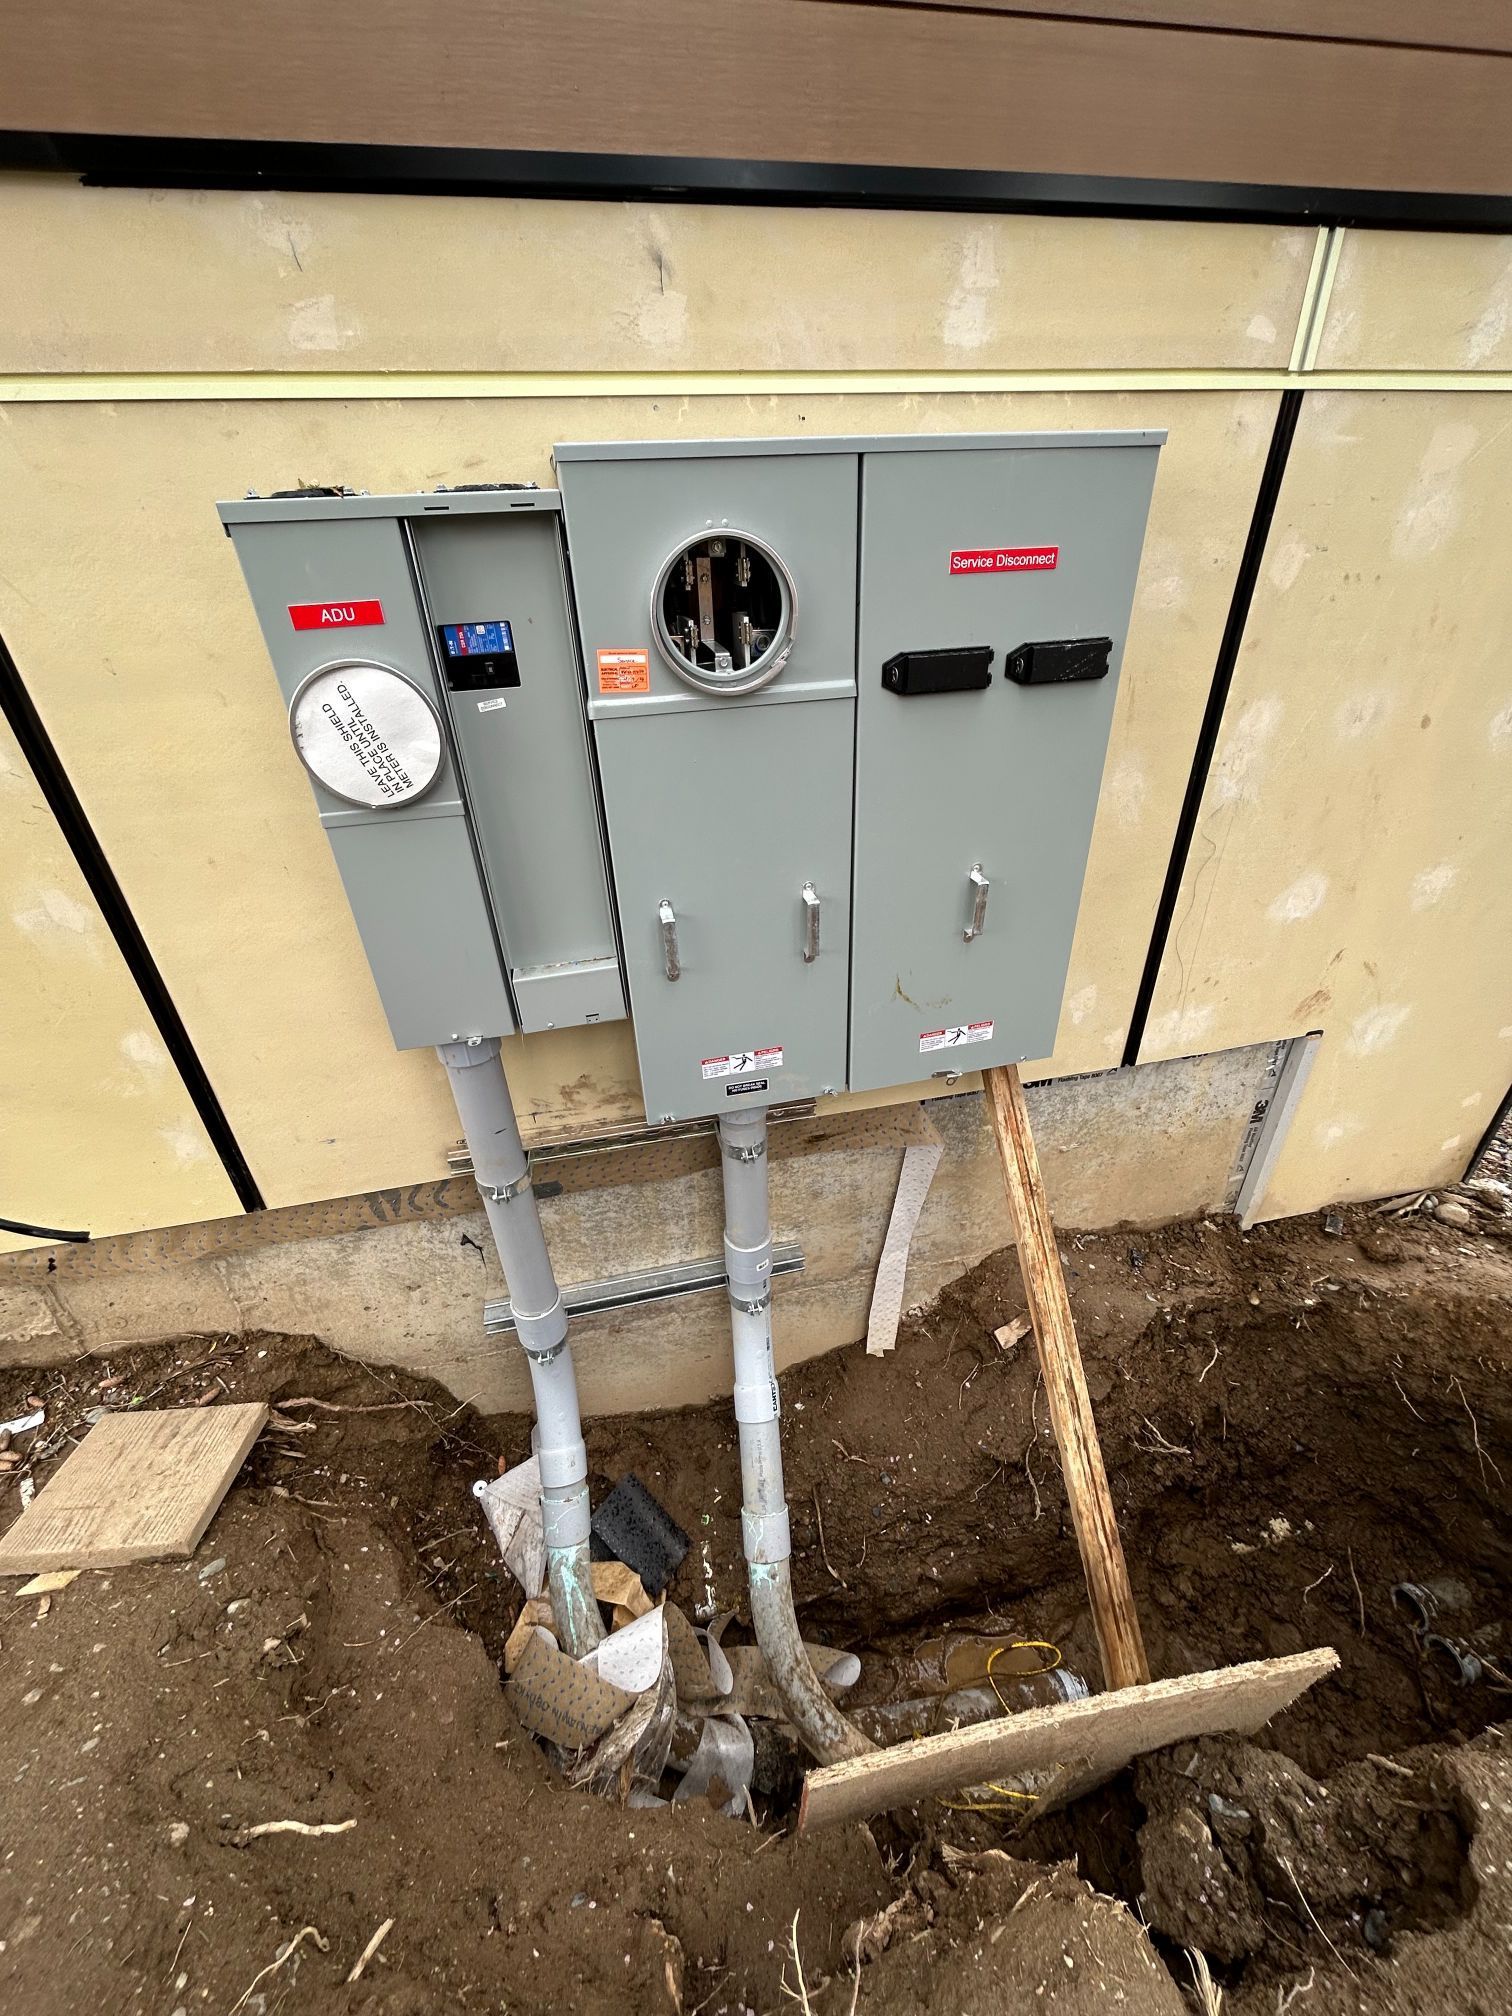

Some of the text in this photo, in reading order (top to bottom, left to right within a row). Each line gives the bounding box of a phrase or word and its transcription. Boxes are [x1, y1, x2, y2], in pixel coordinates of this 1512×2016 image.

[952, 552, 1055, 569] Service Disconnect
[321, 607, 355, 623] ADU
[322, 703, 395, 798] LEAVE THIS SHIELD
[347, 717, 404, 794] IN PLACE UNTIL
[377, 742, 389, 752] IS
[385, 753, 414, 788] METER
[1250, 1099, 1269, 1124] 3M
